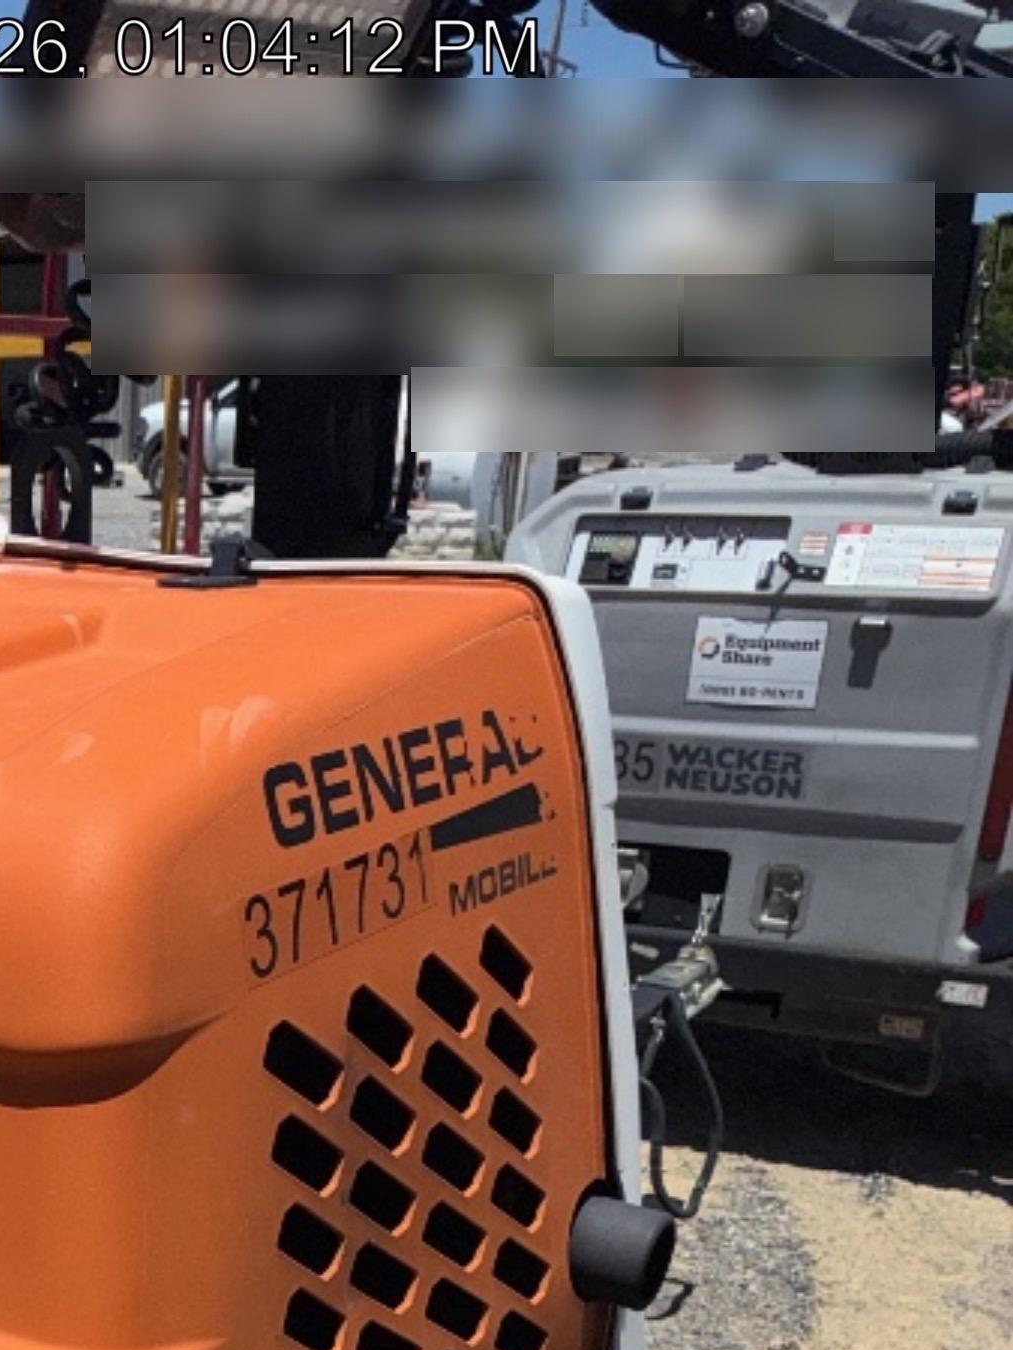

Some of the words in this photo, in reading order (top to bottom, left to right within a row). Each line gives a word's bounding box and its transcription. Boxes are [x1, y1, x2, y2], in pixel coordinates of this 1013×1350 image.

[722, 650, 773, 666] Share
[724, 633, 820, 652] Equipment
[667, 743, 805, 774] WACKER
[665, 767, 803, 799] NEUSON
[244, 831, 426, 978] 371731
